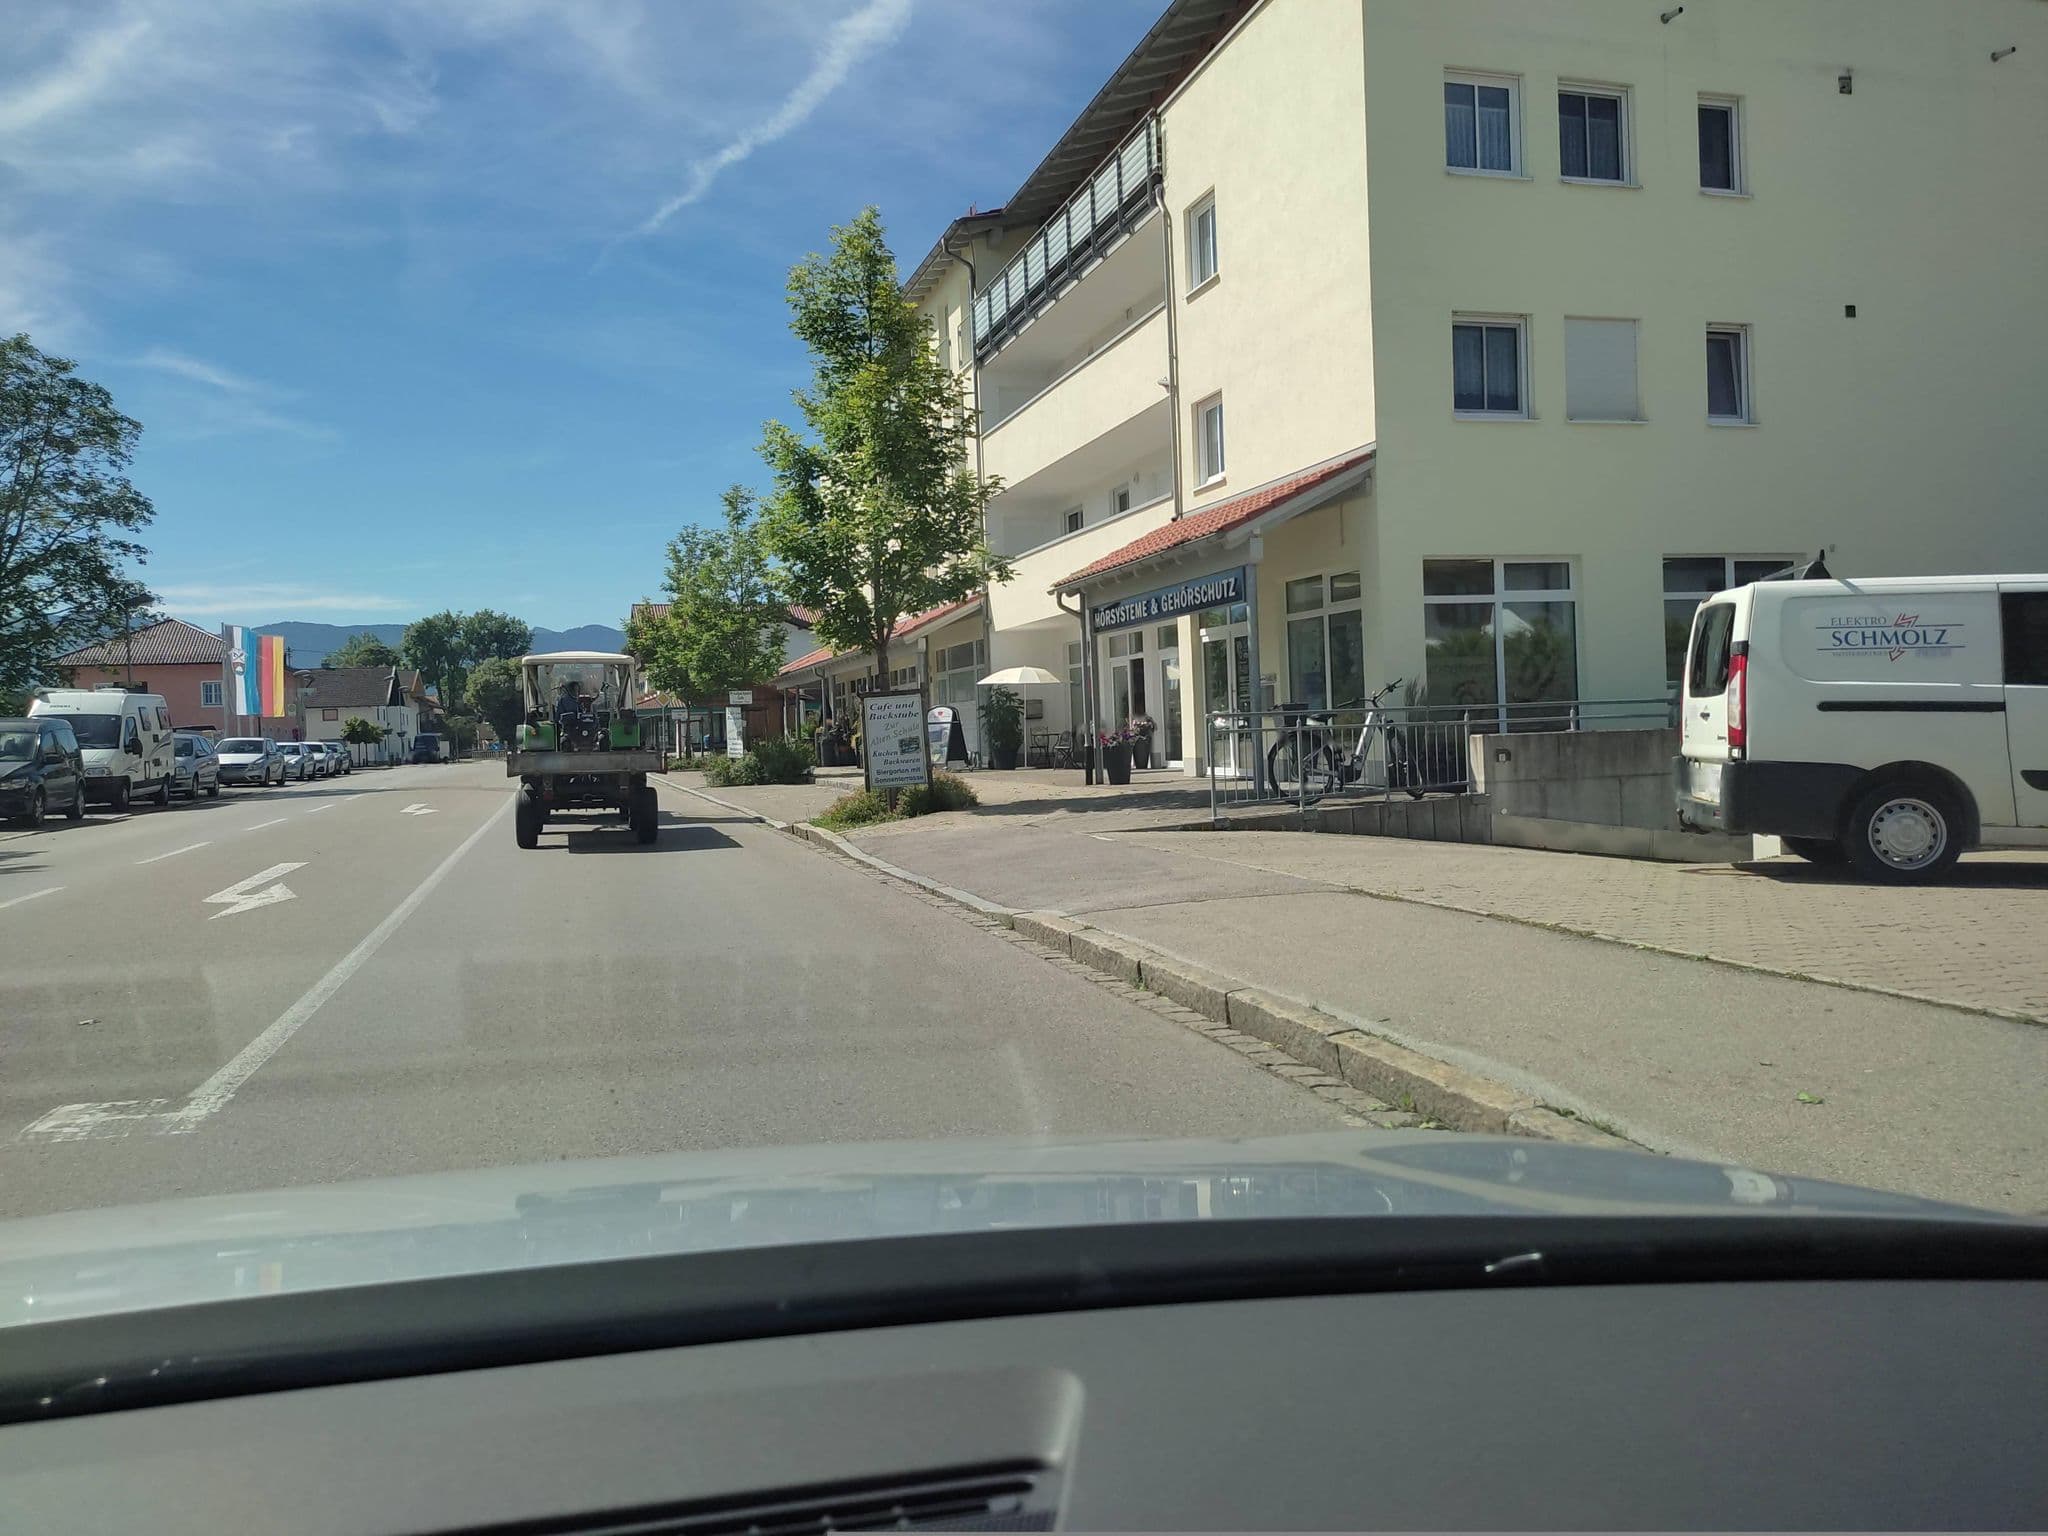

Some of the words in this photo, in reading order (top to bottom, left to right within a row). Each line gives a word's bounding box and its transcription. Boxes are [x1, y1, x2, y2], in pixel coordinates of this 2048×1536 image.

[1095, 602, 1147, 628] HÖRSYSTEME
[1151, 598, 1158, 614] &
[1161, 577, 1236, 612] GEHÖRSCHUTZ
[1831, 616, 1887, 626] ELEKTRO
[895, 701, 915, 709] und
[869, 711, 919, 721] Backstube
[872, 750, 898, 758] Kuchen
